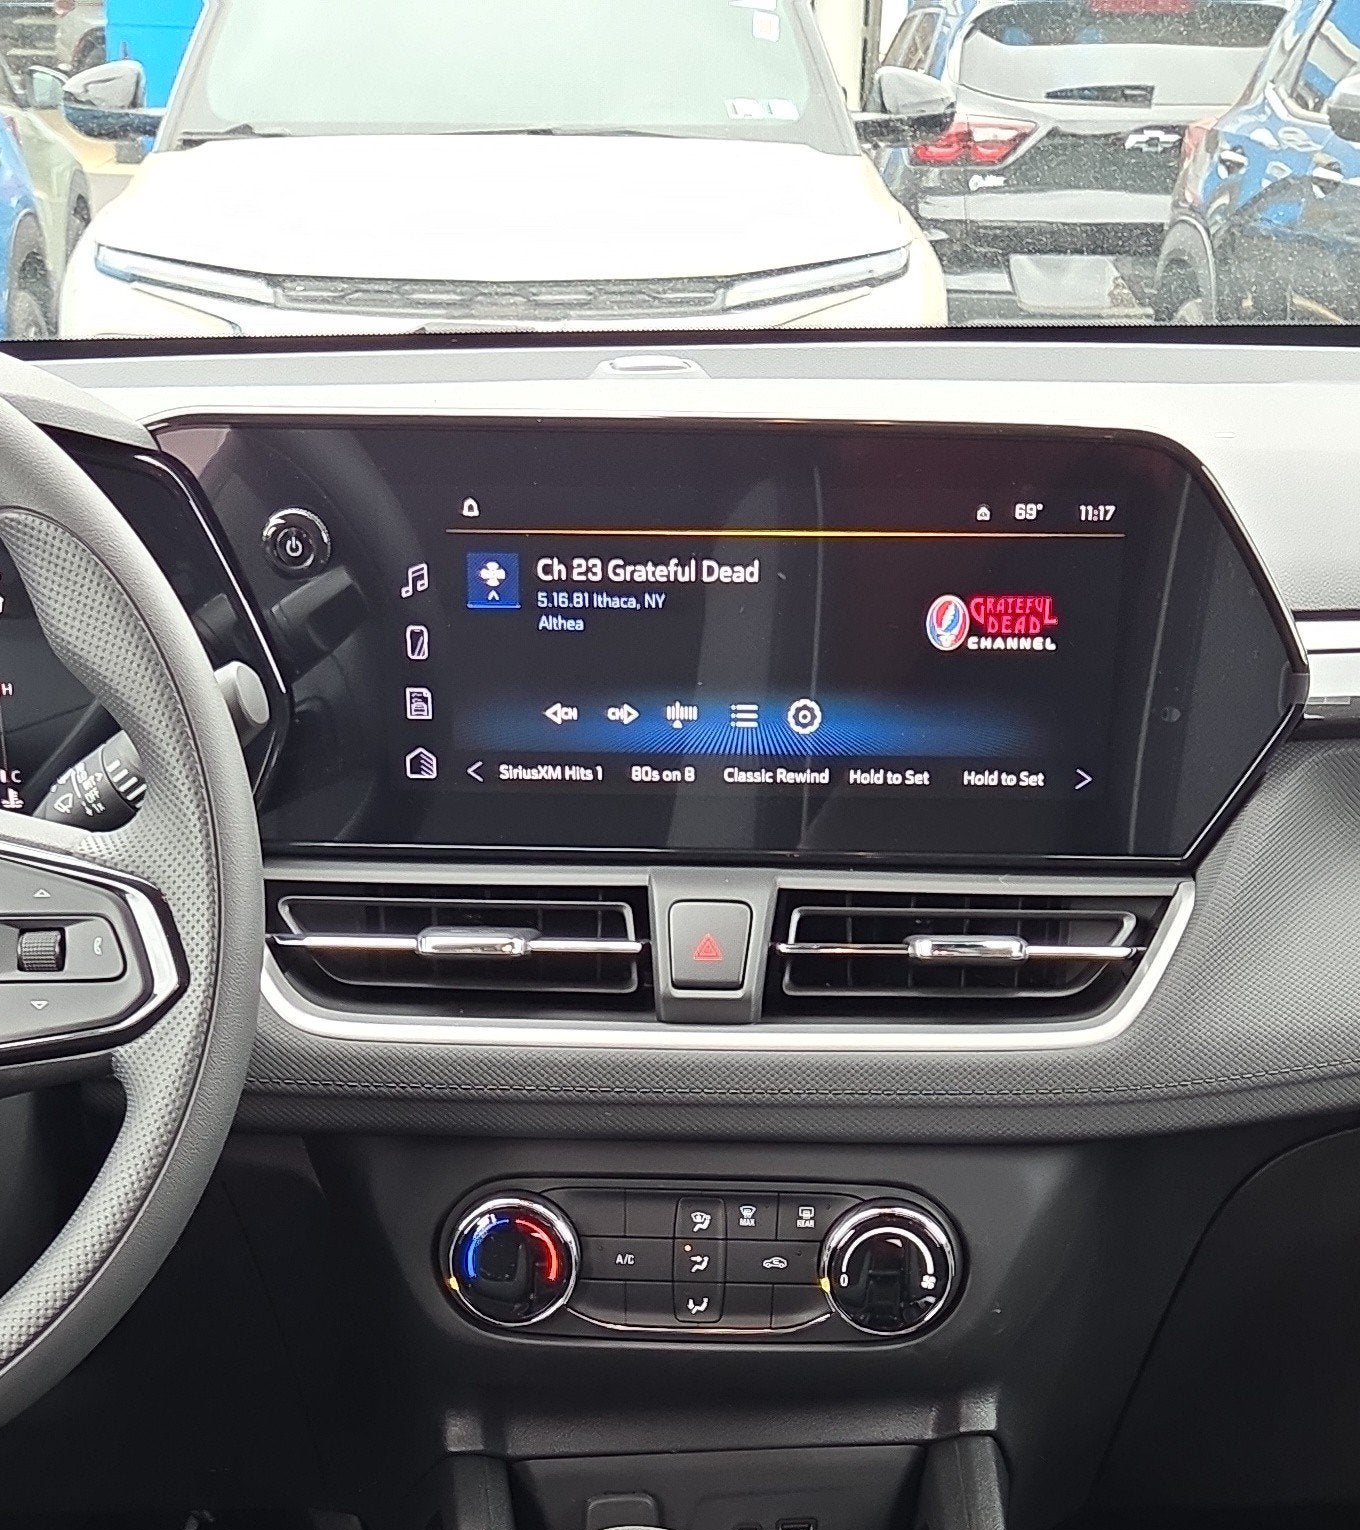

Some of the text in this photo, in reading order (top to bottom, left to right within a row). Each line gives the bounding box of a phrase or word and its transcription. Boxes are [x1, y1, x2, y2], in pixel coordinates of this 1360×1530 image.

[1079, 504, 1116, 521] 11:17
[536, 557, 760, 583] Ch 23 Grateful Dead
[537, 592, 665, 610] 5.16.81 Ithaca, NY
[970, 596, 1058, 625] GRATEFUL
[538, 616, 585, 631] Althea
[987, 616, 1041, 634] DEAD
[967, 636, 1057, 650] CHANNEL
[1, 683, 13, 696] H
[11, 770, 22, 783] C
[499, 764, 603, 781] SiriusXM Hits 1
[631, 765, 660, 782] 80s
[662, 769, 681, 782] on
[723, 768, 829, 784] Classic Rewind
[849, 769, 930, 786] Hold to Set
[963, 770, 1045, 787] Hold to Set
[739, 1217, 756, 1227] MAX
[615, 1253, 636, 1266] A/C
